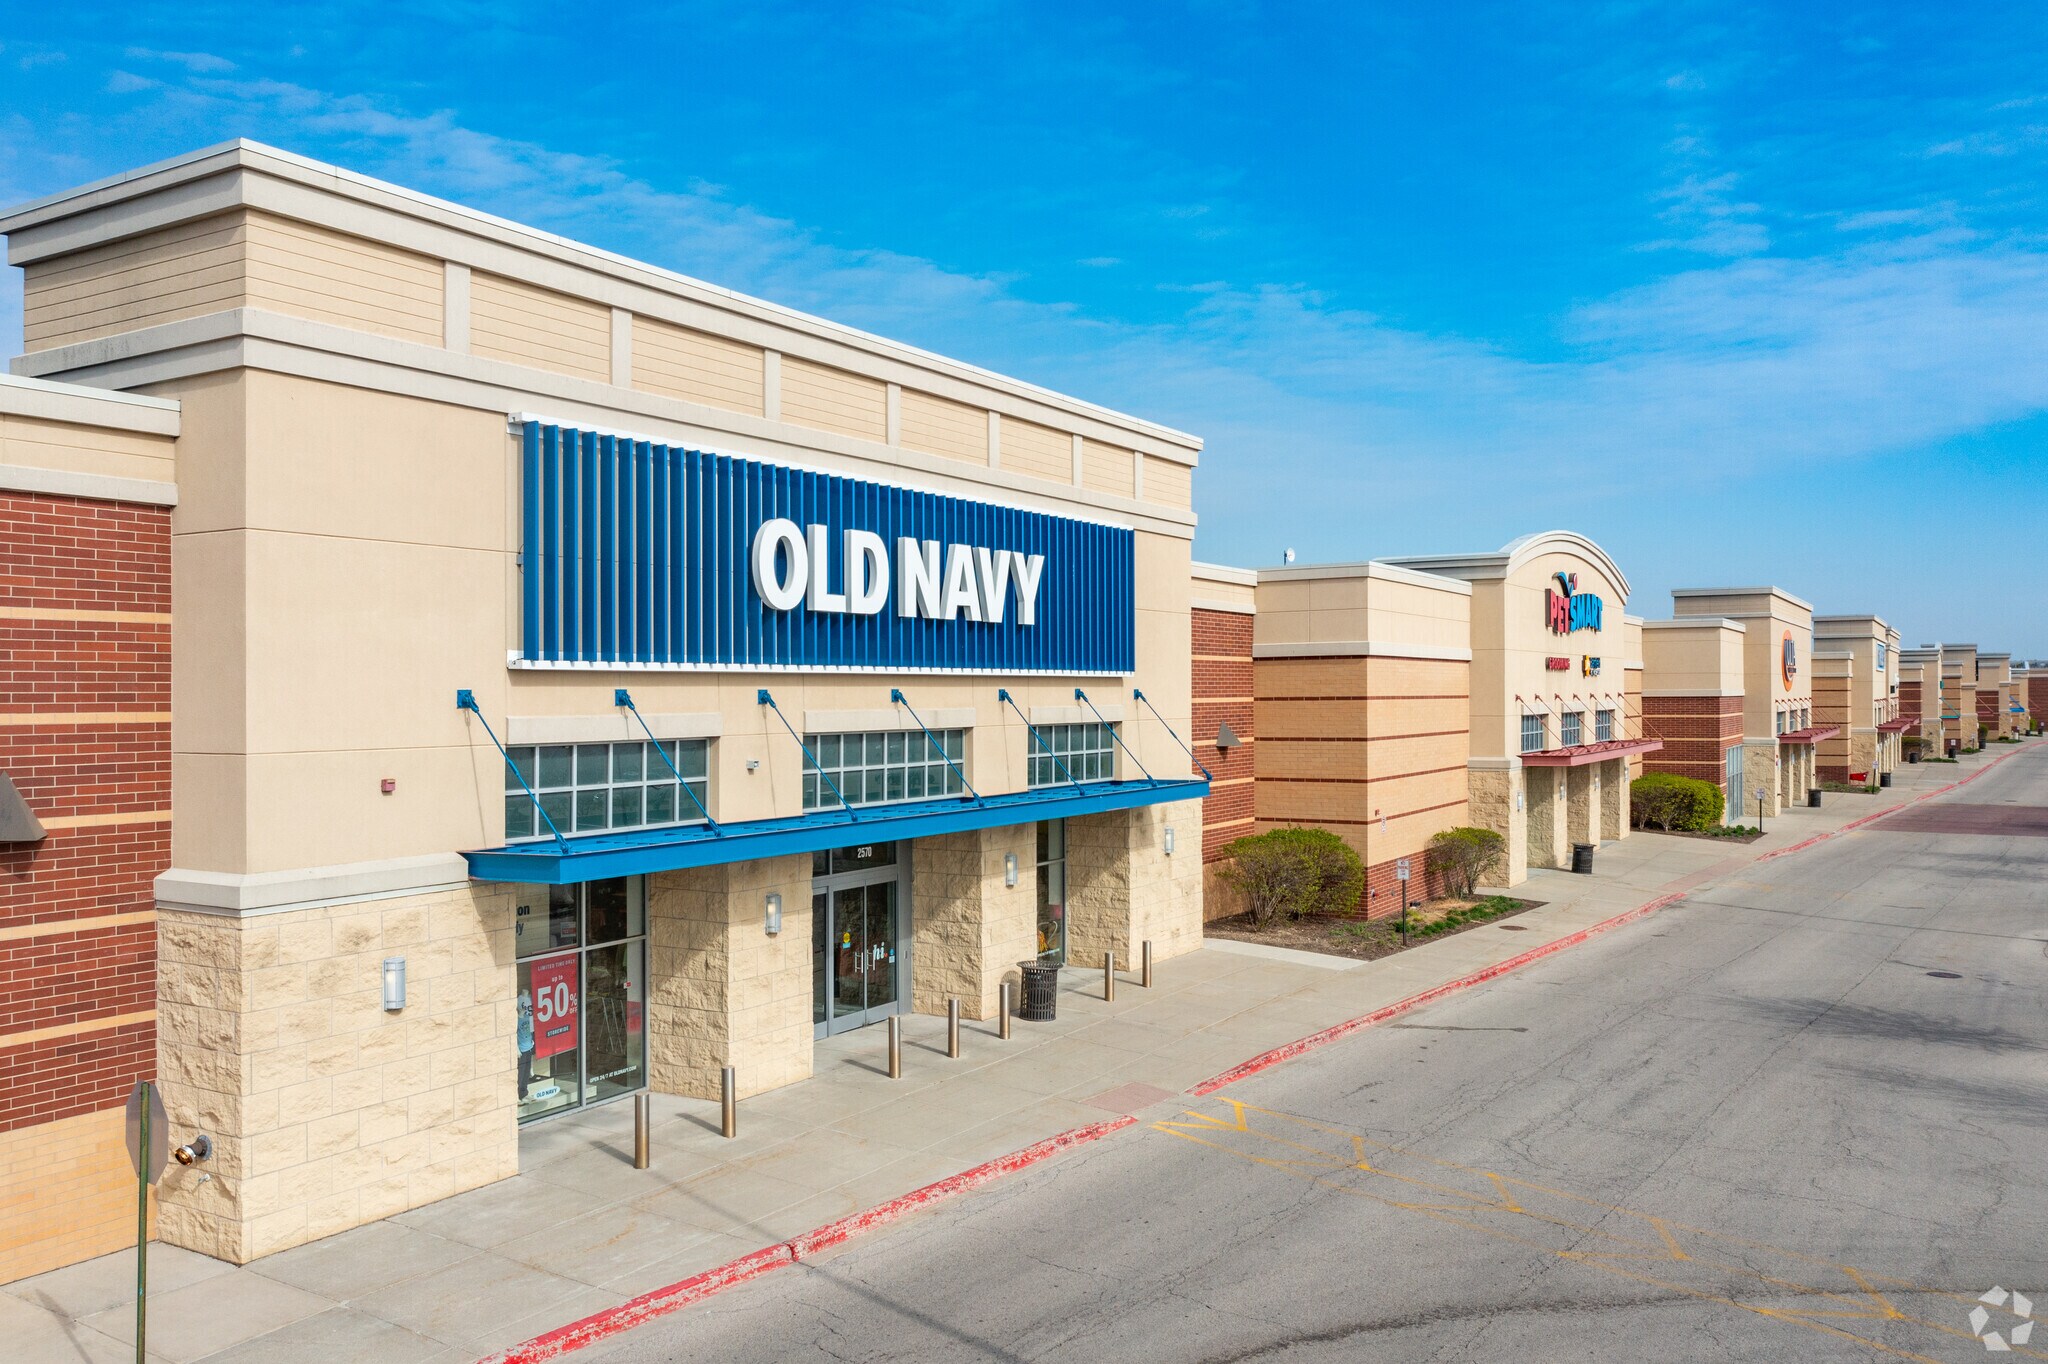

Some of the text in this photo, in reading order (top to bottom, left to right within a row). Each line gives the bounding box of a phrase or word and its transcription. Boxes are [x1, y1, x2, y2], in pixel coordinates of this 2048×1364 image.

[752, 517, 1045, 626] OLD NAVY
[1546, 588, 1603, 634] PETSMART
[857, 846, 873, 859] 2570
[537, 958, 575, 972] LIMITED TIME ONLY
[551, 975, 558, 983] up
[545, 1087, 557, 1096] NAVY
